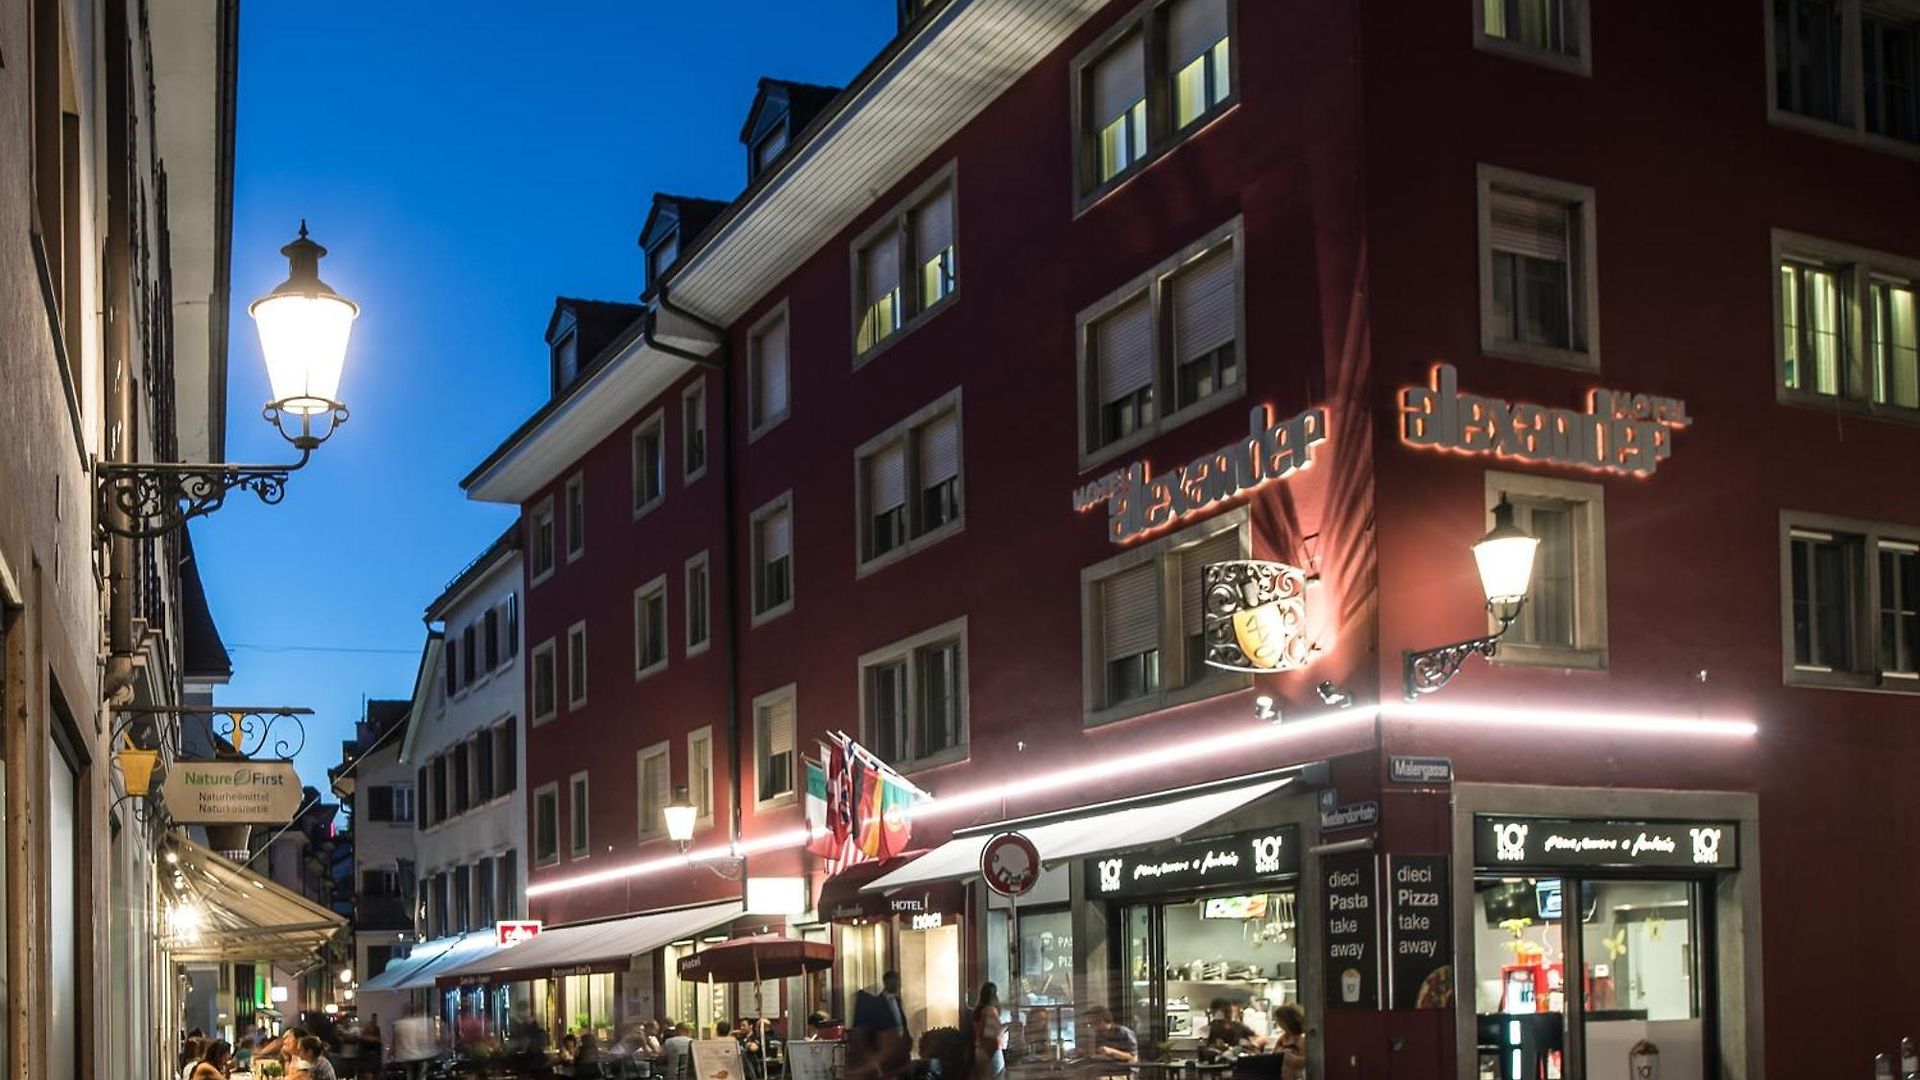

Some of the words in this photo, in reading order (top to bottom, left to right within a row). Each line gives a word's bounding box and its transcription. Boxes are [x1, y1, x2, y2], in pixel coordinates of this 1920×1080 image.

[184, 771, 231, 785] Nature
[252, 772, 283, 785] First
[1394, 759, 1449, 781] Malergasse
[1329, 869, 1359, 888] dieci
[1397, 866, 1432, 882] dieci
[891, 900, 924, 911] HOTEL
[1330, 893, 1368, 911] Pasta
[1398, 889, 1439, 906] Pizza
[1330, 917, 1358, 933] take
[1399, 914, 1430, 930] take
[1330, 943, 1364, 960] away
[1399, 940, 1437, 958] away
